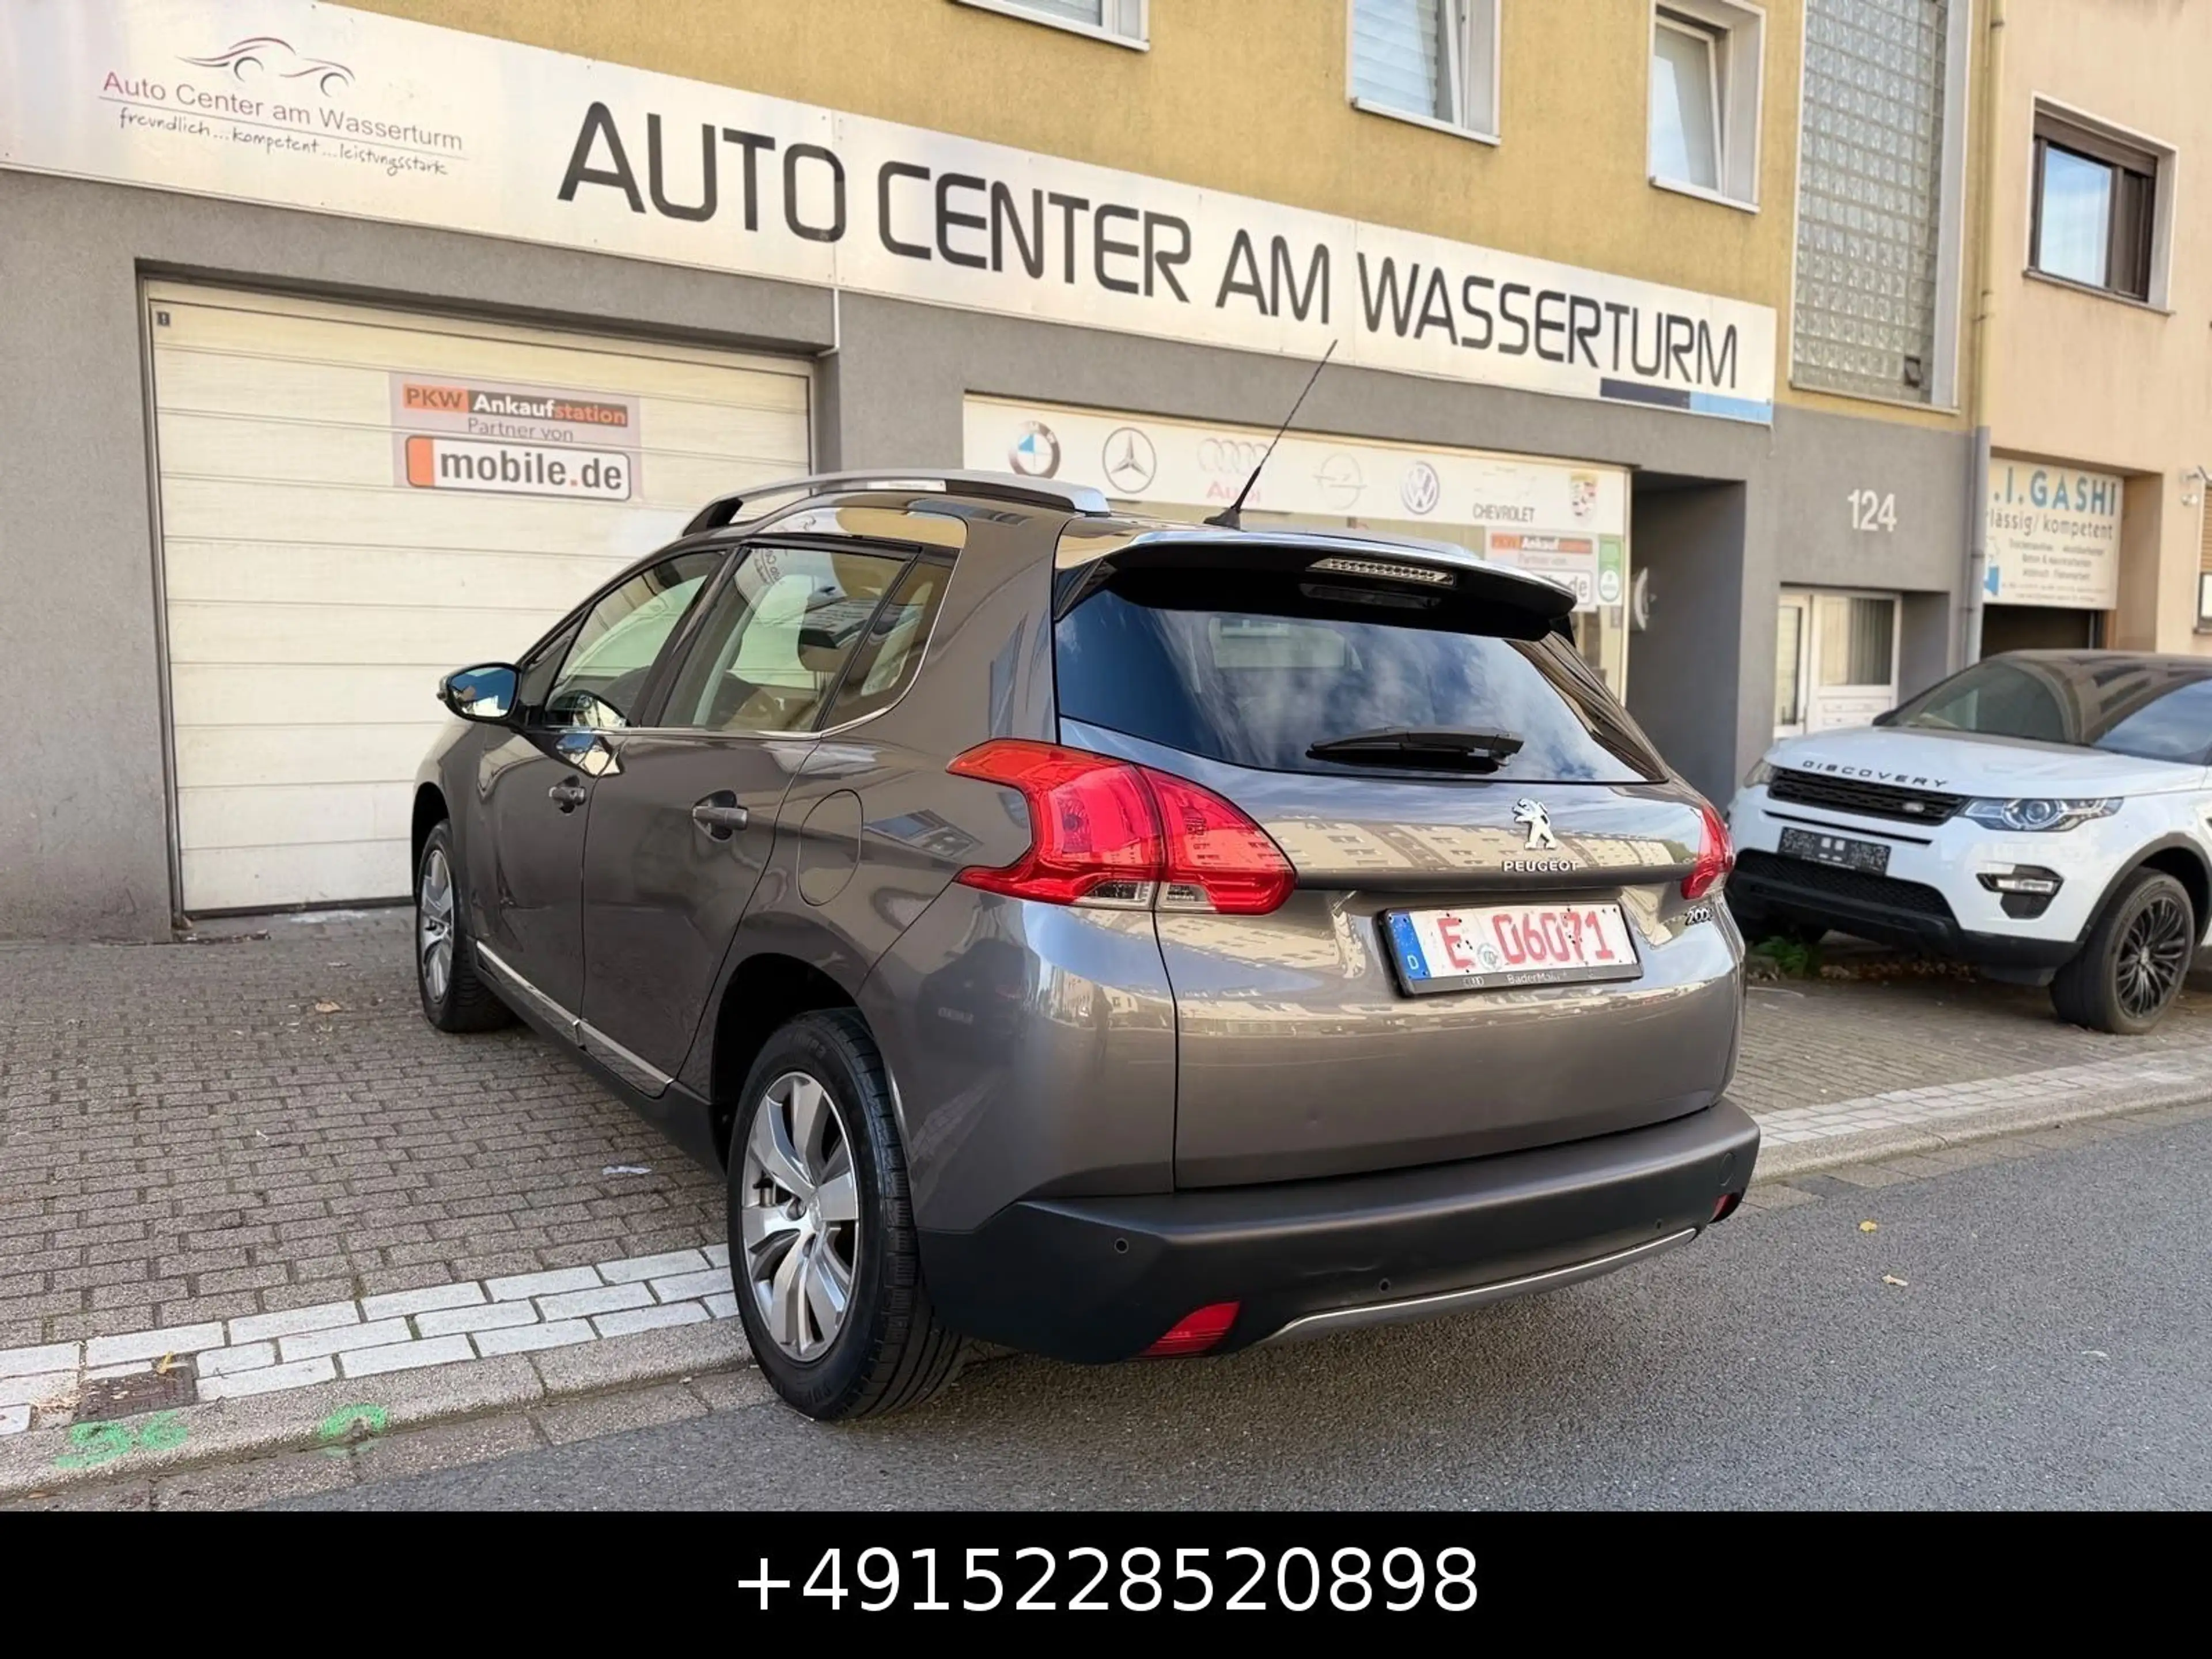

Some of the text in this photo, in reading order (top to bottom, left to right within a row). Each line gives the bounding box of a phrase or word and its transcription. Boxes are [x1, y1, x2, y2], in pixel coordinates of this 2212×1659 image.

[104, 71, 462, 150] Auto Center am Wasserturm
[557, 100, 1737, 389] AUTO CENTER AM WASSERTURM
[406, 386, 626, 425] PKW Ankaufstation
[468, 417, 574, 442] Partner von
[440, 449, 622, 490] mobile.de
[1472, 502, 1535, 523] CHEVROLET
[1847, 488, 1897, 532] 124
[1802, 760, 1948, 787] DISCOVERY
[1502, 859, 1578, 873] PEUGEOT
[1437, 916, 1476, 970] E
[1491, 911, 1615, 964] 06071
